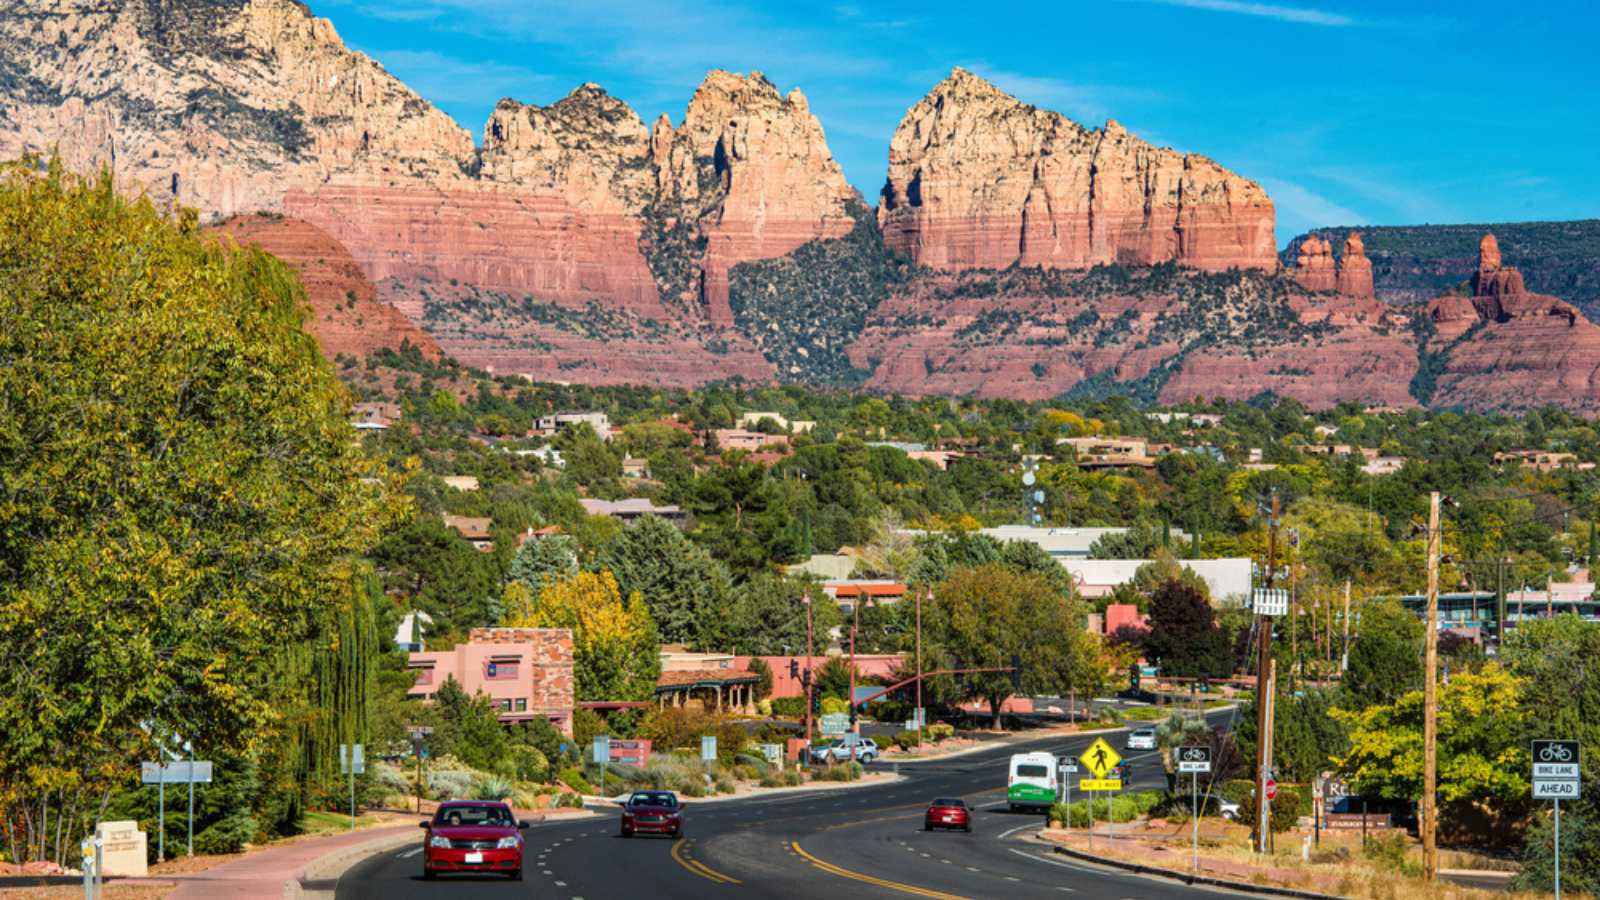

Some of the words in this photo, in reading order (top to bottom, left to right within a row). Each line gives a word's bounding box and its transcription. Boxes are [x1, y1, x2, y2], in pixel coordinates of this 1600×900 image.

[1539, 766, 1553, 774] BIKE
[1555, 766, 1573, 774] LANE
[1540, 784, 1574, 793] AHEAD
